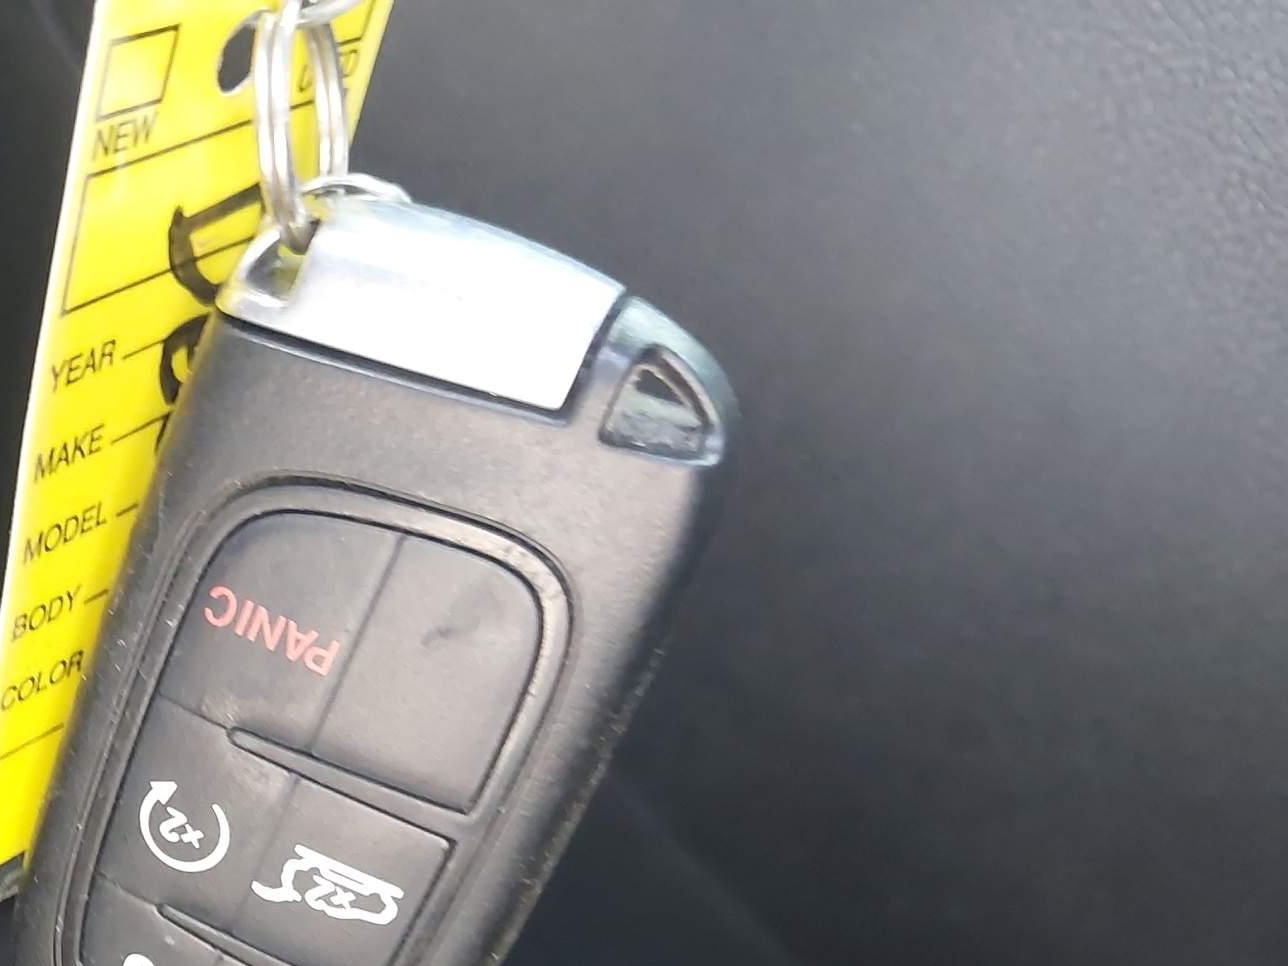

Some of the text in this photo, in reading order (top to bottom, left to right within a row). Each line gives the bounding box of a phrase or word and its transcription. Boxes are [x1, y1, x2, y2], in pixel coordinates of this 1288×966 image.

[297, 48, 360, 94] UD
[92, 111, 158, 160] NEW
[50, 339, 116, 392] YEAR
[33, 423, 105, 484] MAKE
[22, 501, 107, 565] MODEL
[11, 585, 81, 642] BODY
[203, 585, 340, 676] PANIC
[0, 650, 84, 711] COLOR
